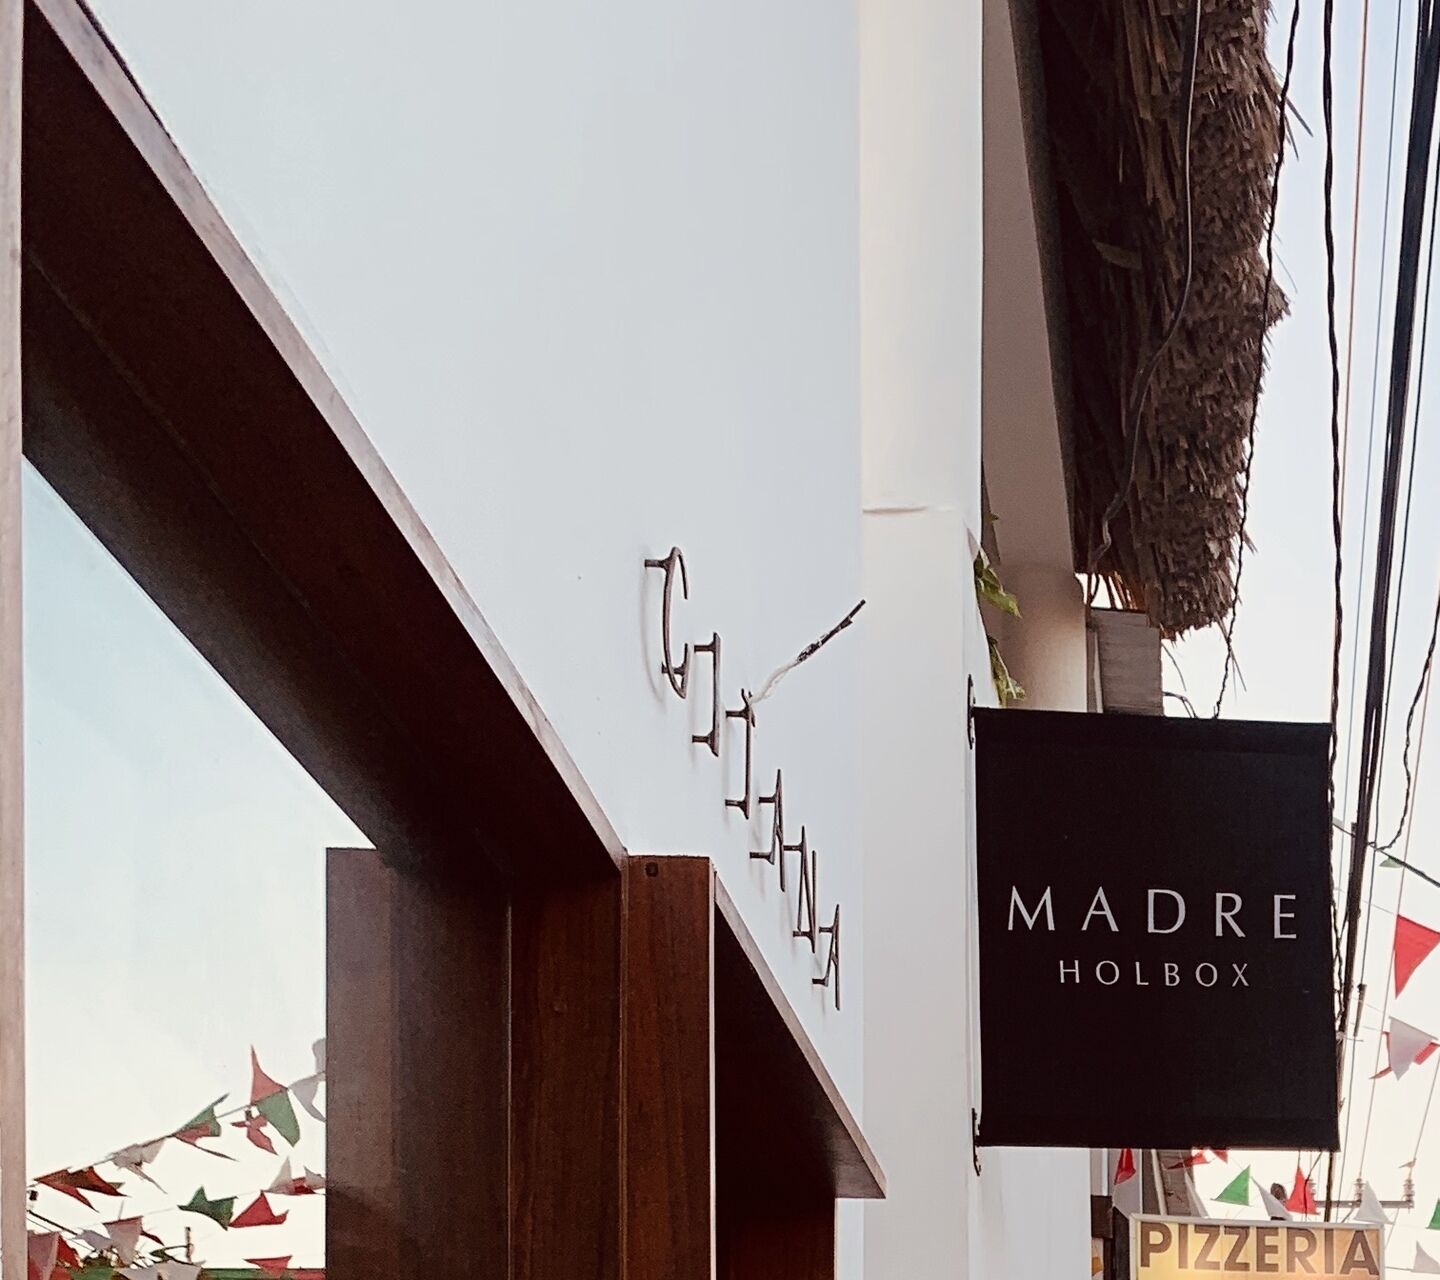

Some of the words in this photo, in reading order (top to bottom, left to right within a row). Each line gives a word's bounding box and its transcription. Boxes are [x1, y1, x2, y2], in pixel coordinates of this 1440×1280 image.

[1007, 886, 1297, 939] MADRE
[1059, 959, 1249, 987] HOLBOX
[1140, 1222, 1379, 1275] PIZZERIA
